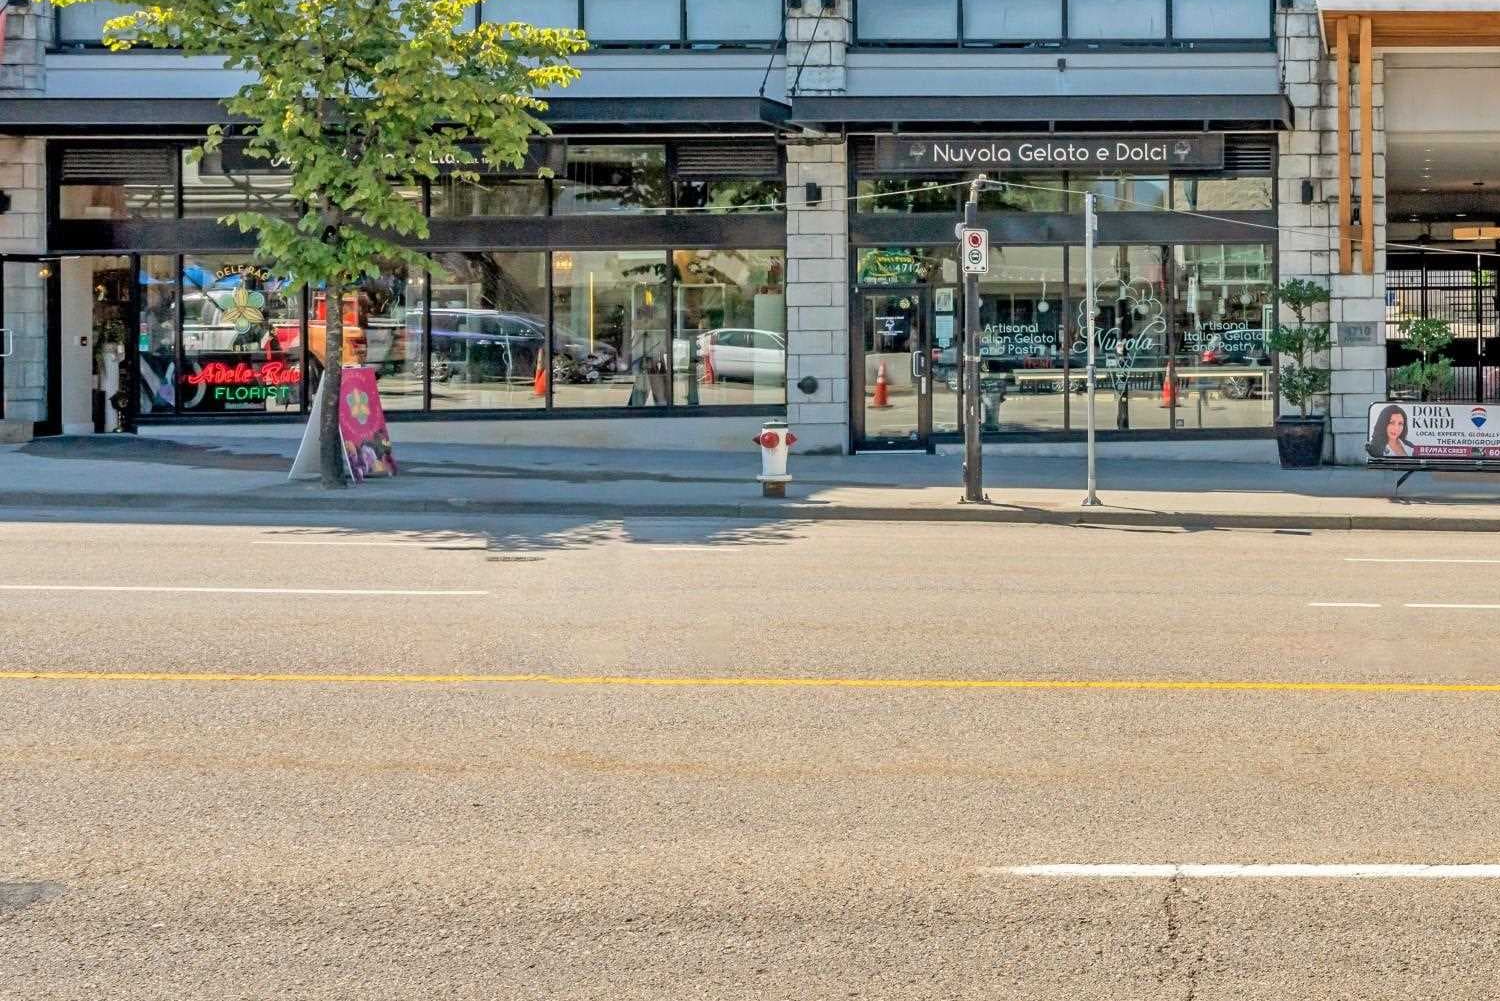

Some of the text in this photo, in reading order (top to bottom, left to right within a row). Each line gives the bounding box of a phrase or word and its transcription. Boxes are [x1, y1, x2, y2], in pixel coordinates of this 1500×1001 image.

[934, 143, 1167, 162] Nuvola Gelato e Dolci
[984, 323, 1039, 333] Artisanal
[1195, 321, 1249, 330] Artisanal
[1014, 333, 1055, 343] Gelato
[1224, 331, 1264, 341] Gelato
[1008, 344, 1046, 356] Pastr
[1219, 341, 1256, 353] Pastry
[215, 387, 289, 400] FLORIST
[1412, 406, 1451, 417] DORA
[1412, 418, 1454, 429] KARDI
